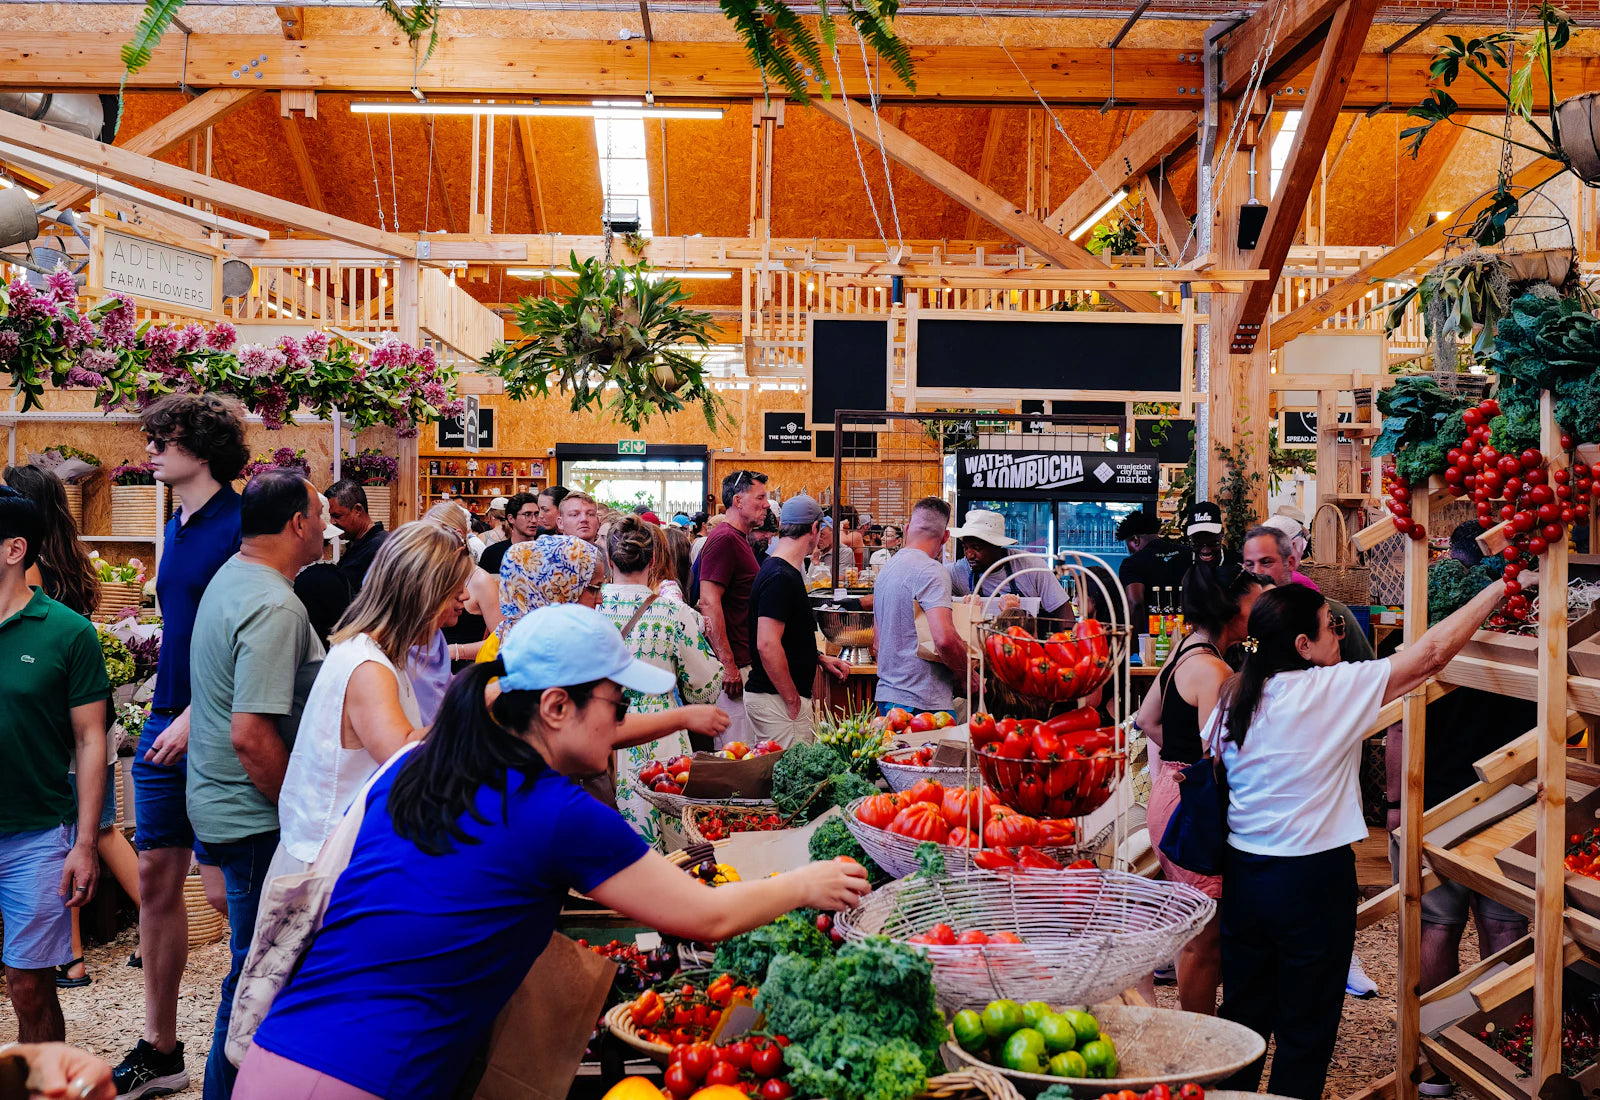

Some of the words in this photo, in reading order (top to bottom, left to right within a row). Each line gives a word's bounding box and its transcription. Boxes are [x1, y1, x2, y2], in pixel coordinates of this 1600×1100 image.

[113, 241, 203, 281] ADENE'S
[111, 271, 146, 290] FARM
[152, 281, 204, 303] FLOWERS
[964, 454, 1014, 475] WATER
[972, 472, 984, 488] &
[986, 455, 1084, 488] KOMBUCHA
[1116, 475, 1153, 484] market
